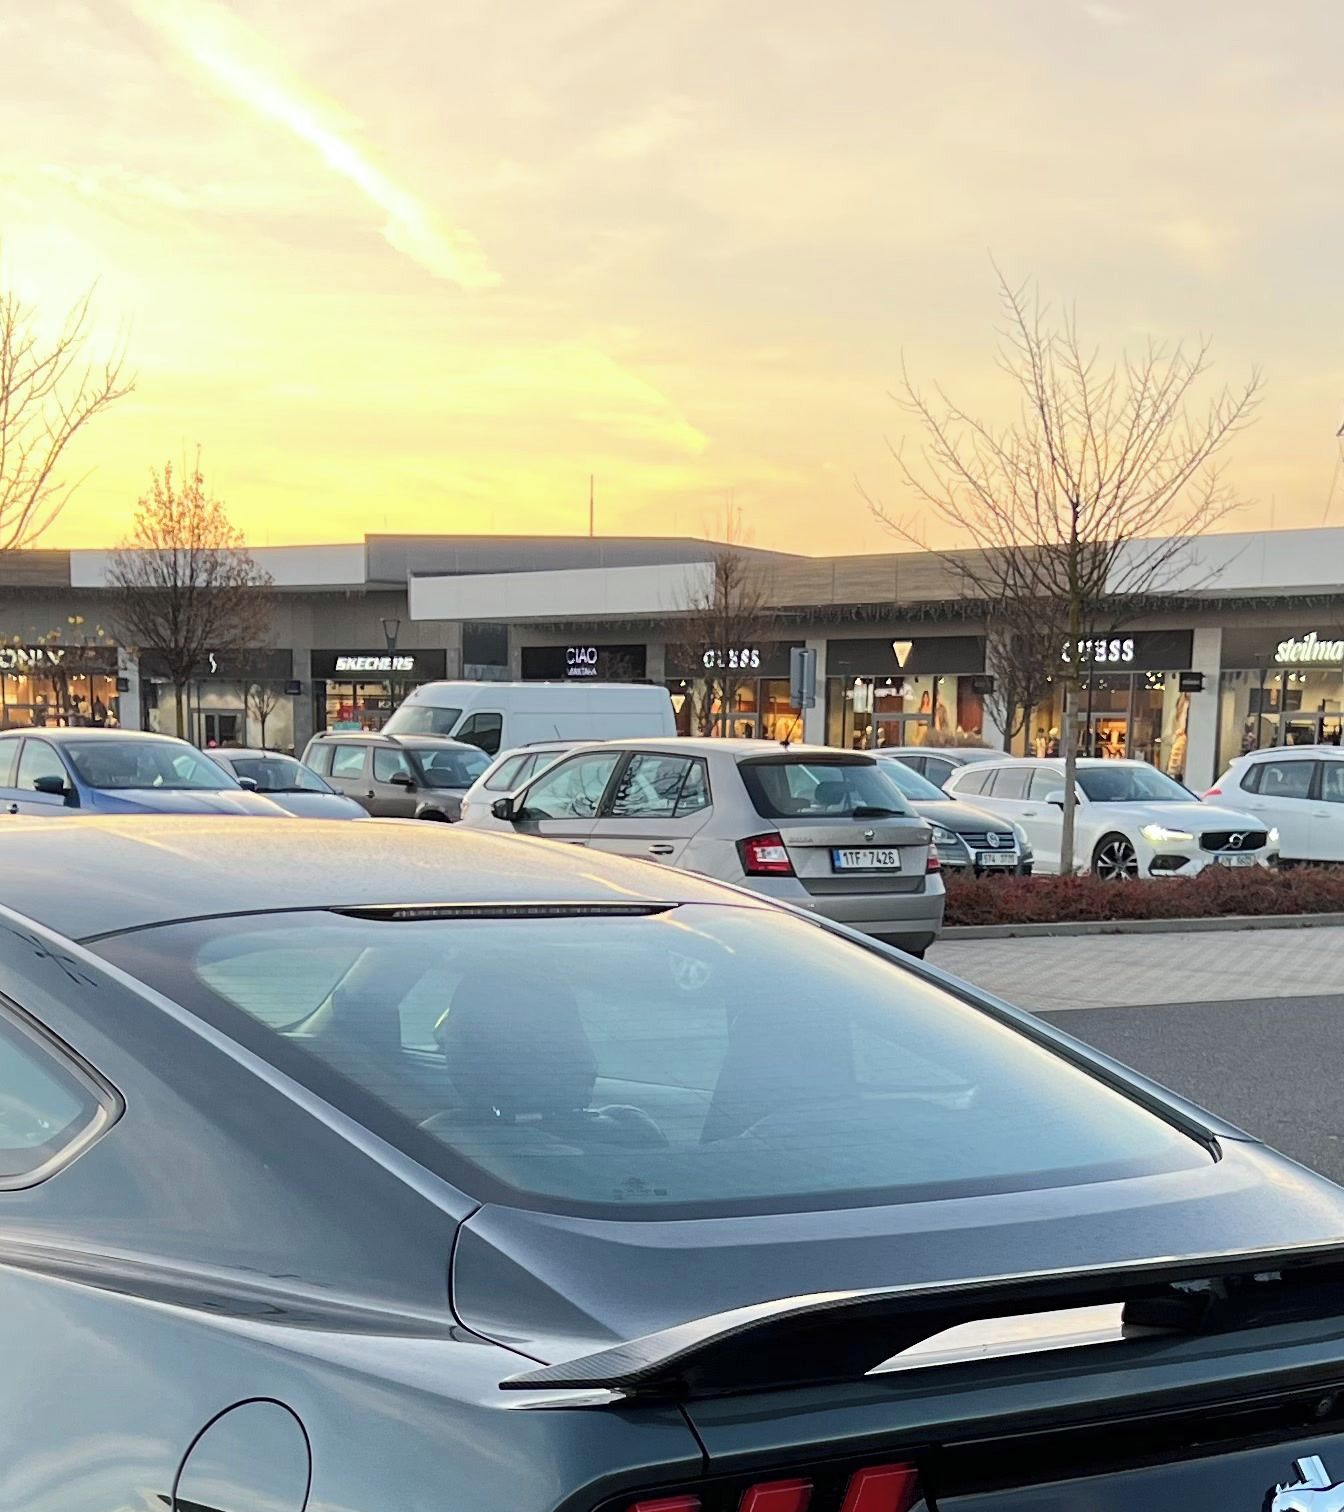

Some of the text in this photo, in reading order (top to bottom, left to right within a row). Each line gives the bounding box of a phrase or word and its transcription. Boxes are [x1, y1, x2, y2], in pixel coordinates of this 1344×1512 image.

[335, 656, 415, 671] SKECHERS
[566, 647, 598, 665] CIAO
[842, 851, 895, 866] 1TF 7426
